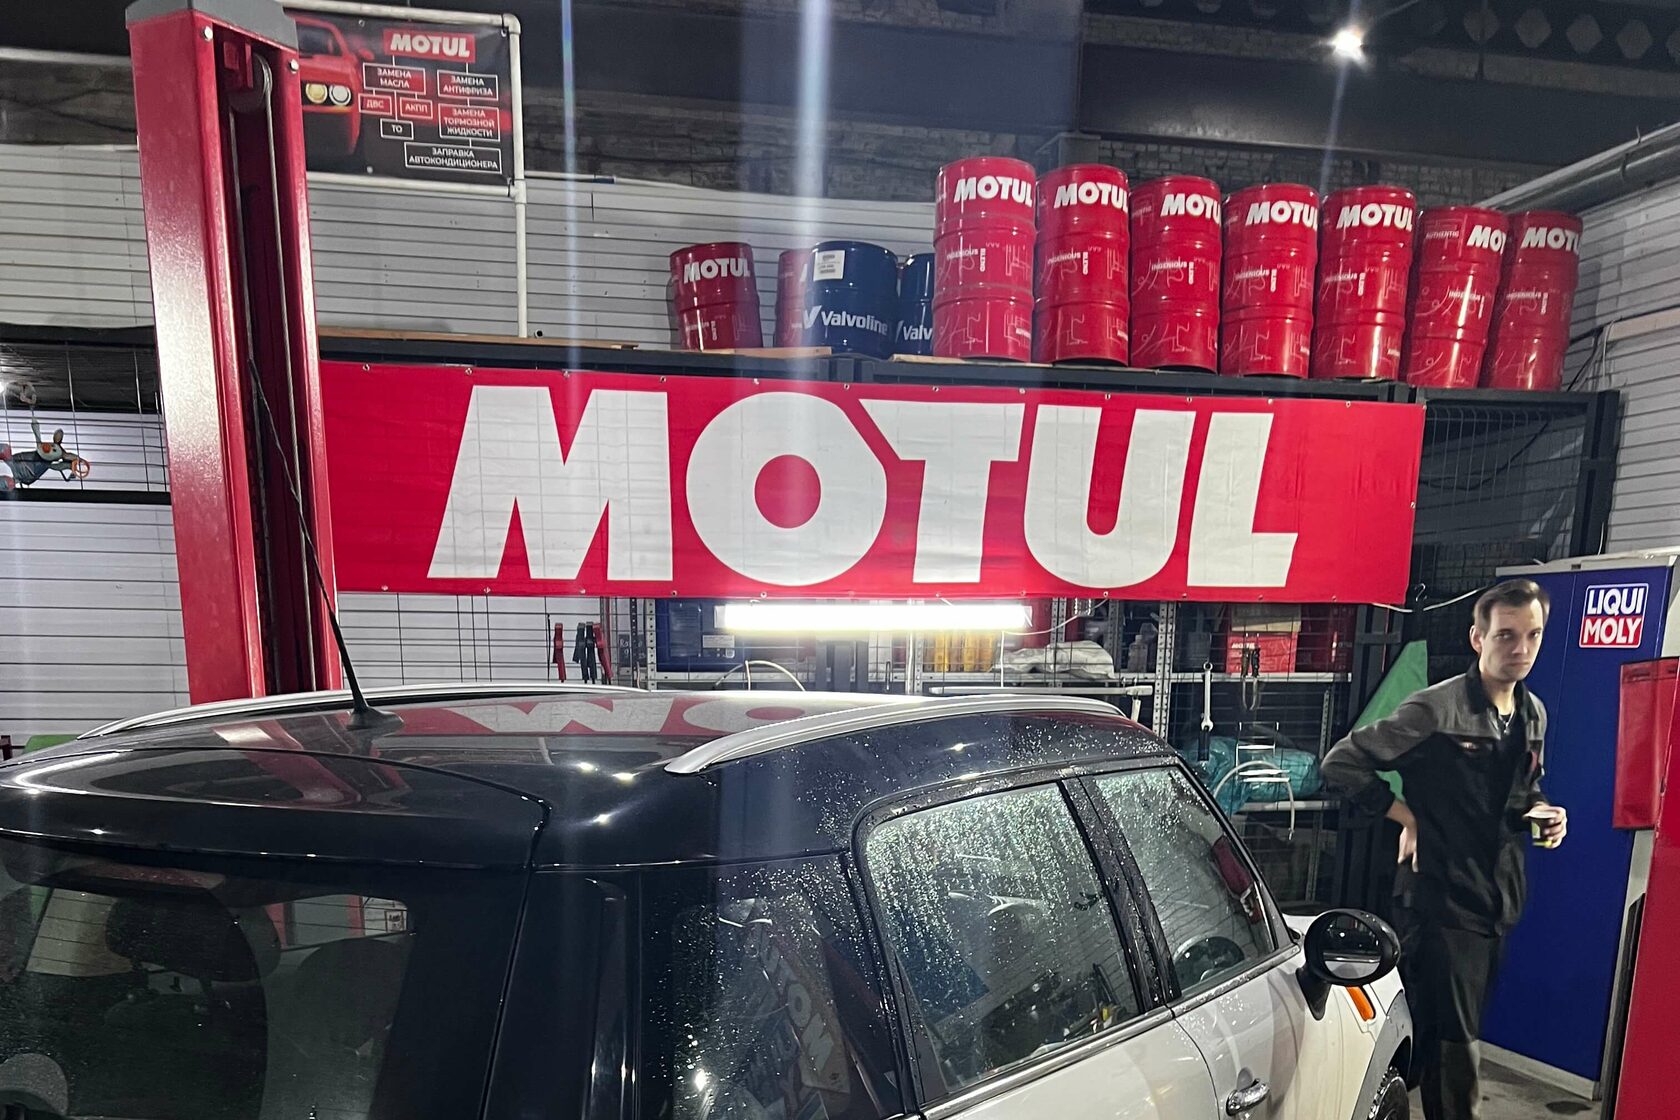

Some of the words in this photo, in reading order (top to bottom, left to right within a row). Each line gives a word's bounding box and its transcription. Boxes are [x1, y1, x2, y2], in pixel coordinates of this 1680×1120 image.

[390, 33, 470, 57] MOTUL
[377, 67, 412, 78] ЗАМЕНА
[380, 78, 410, 88] МАСЛА
[451, 75, 485, 86] ЗАМЕНА
[443, 84, 493, 96] АНТИФРИЗА
[366, 99, 385, 109] ДВС
[405, 103, 428, 114] АКПП
[452, 108, 486, 118] ЗАМЕНА
[391, 124, 403, 134] ТО
[443, 117, 495, 129] ТОРМОЗНОЙ
[446, 126, 493, 137] ЖИДКОСТИ
[432, 147, 475, 158] ЗАПРАВКА
[408, 155, 499, 169] АВТОКОНДИЦИОНЕРА
[954, 175, 1033, 208] MOTUL
[1160, 193, 1221, 226] MOTU
[1336, 203, 1413, 232] MOTUL
[683, 258, 750, 284] MOTUL
[821, 311, 888, 336] Valvoline
[903, 324, 933, 341] Valv
[427, 384, 1298, 588] MOTUL
[1587, 588, 1645, 617] LIQUI
[1583, 616, 1642, 644] MOLY
